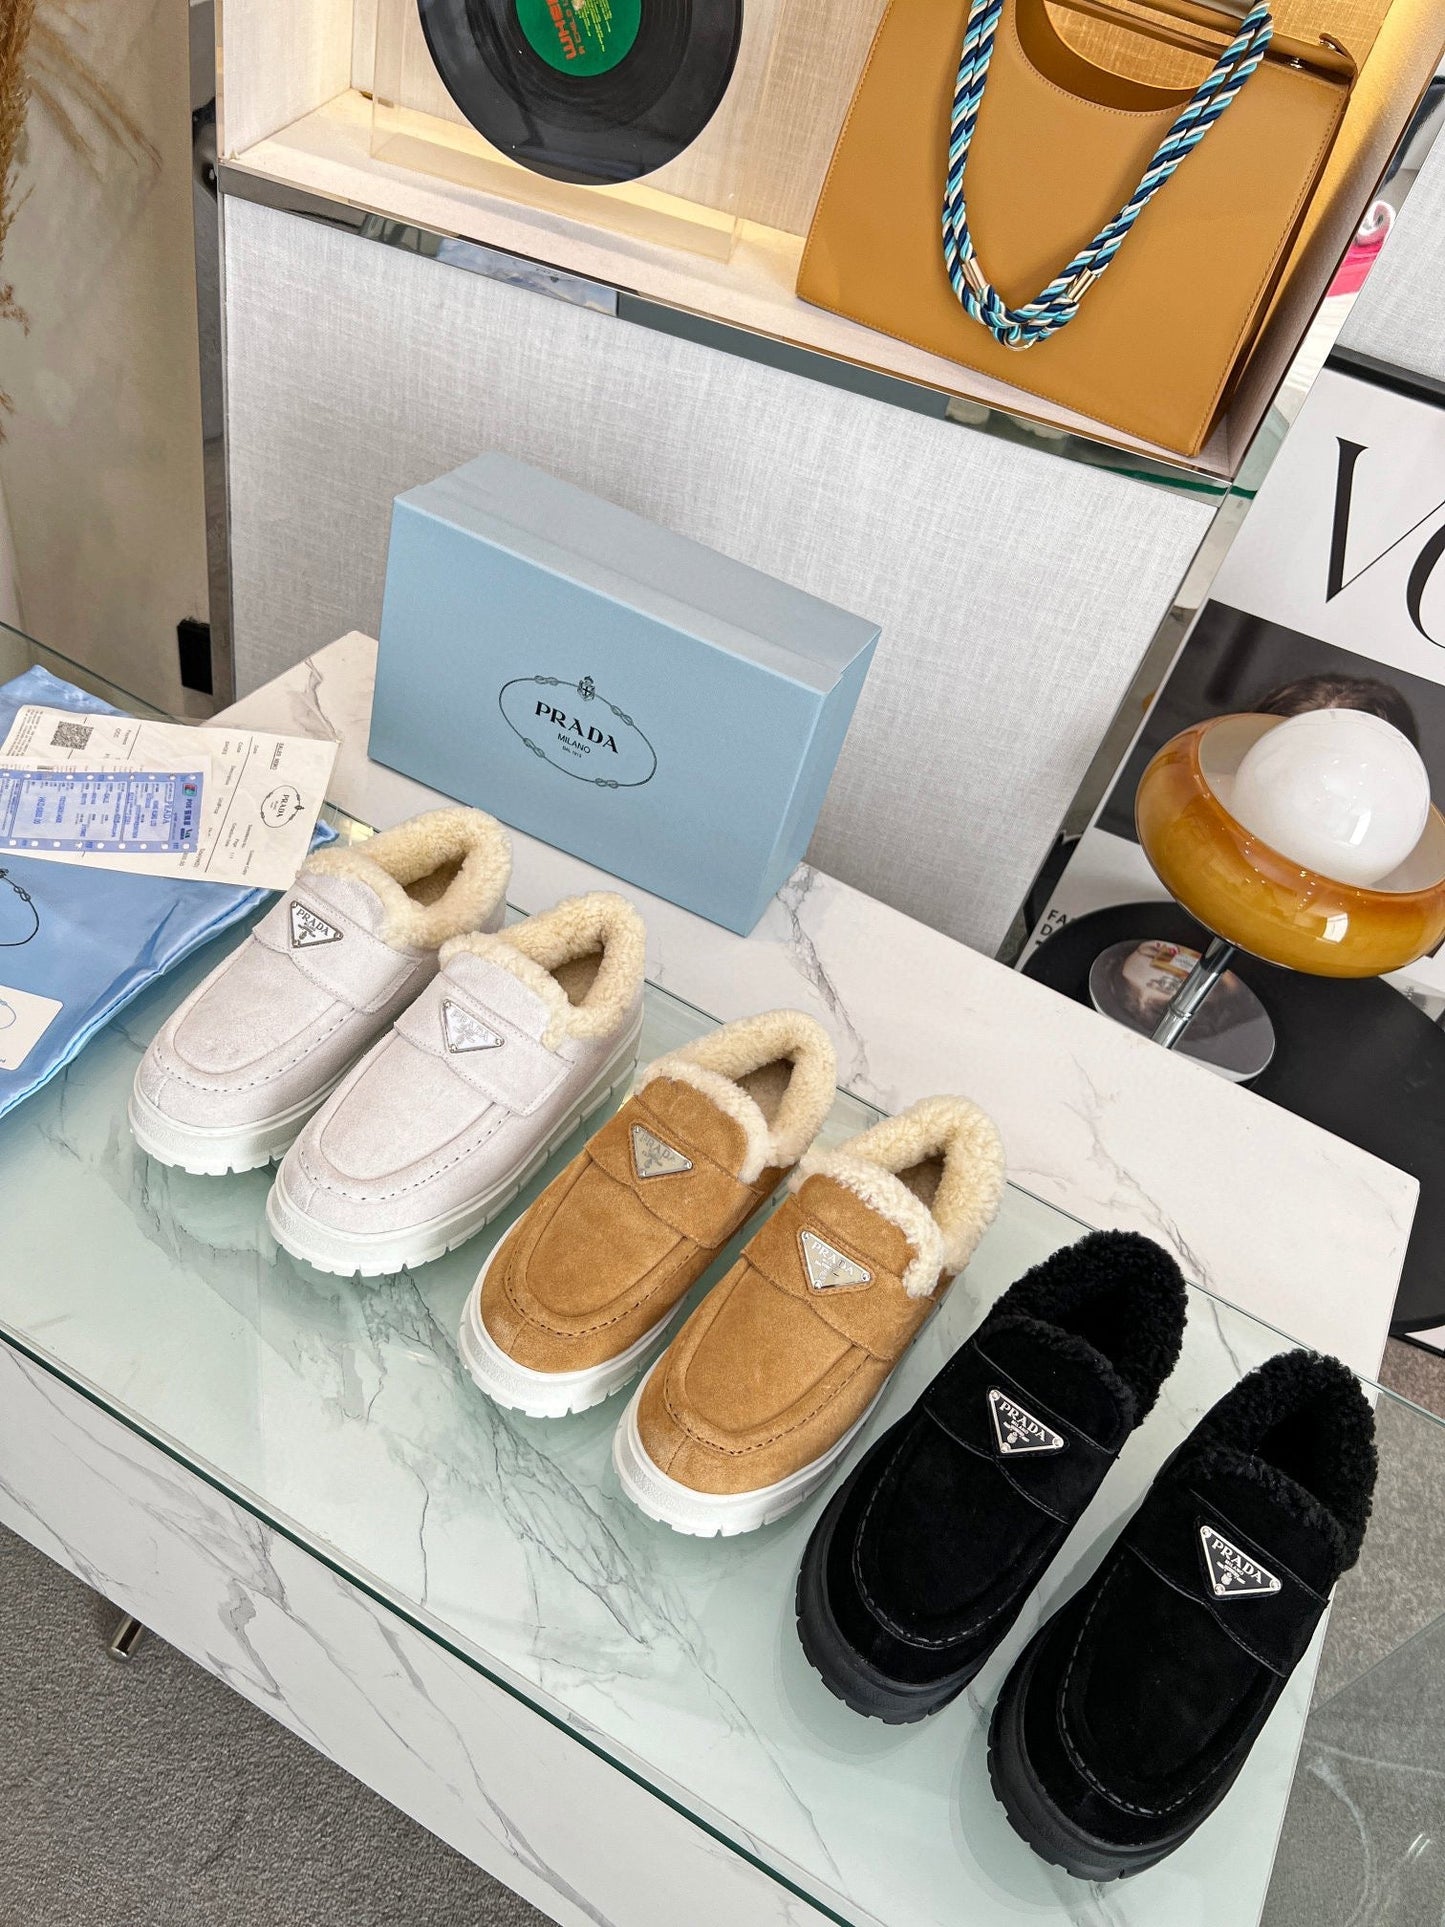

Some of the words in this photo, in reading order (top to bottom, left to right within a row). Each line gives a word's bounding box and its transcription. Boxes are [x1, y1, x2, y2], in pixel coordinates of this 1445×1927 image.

[535, 701, 619, 754] PRADA
[558, 733, 591, 753] MILANO
[276, 794, 290, 818] PRADA
[296, 909, 329, 936] PRADA
[1047, 909, 1071, 925] FA
[811, 1242, 854, 1276] PRADA
[1000, 1401, 1046, 1442] PRADA
[1211, 1539, 1262, 1584] PRADA
